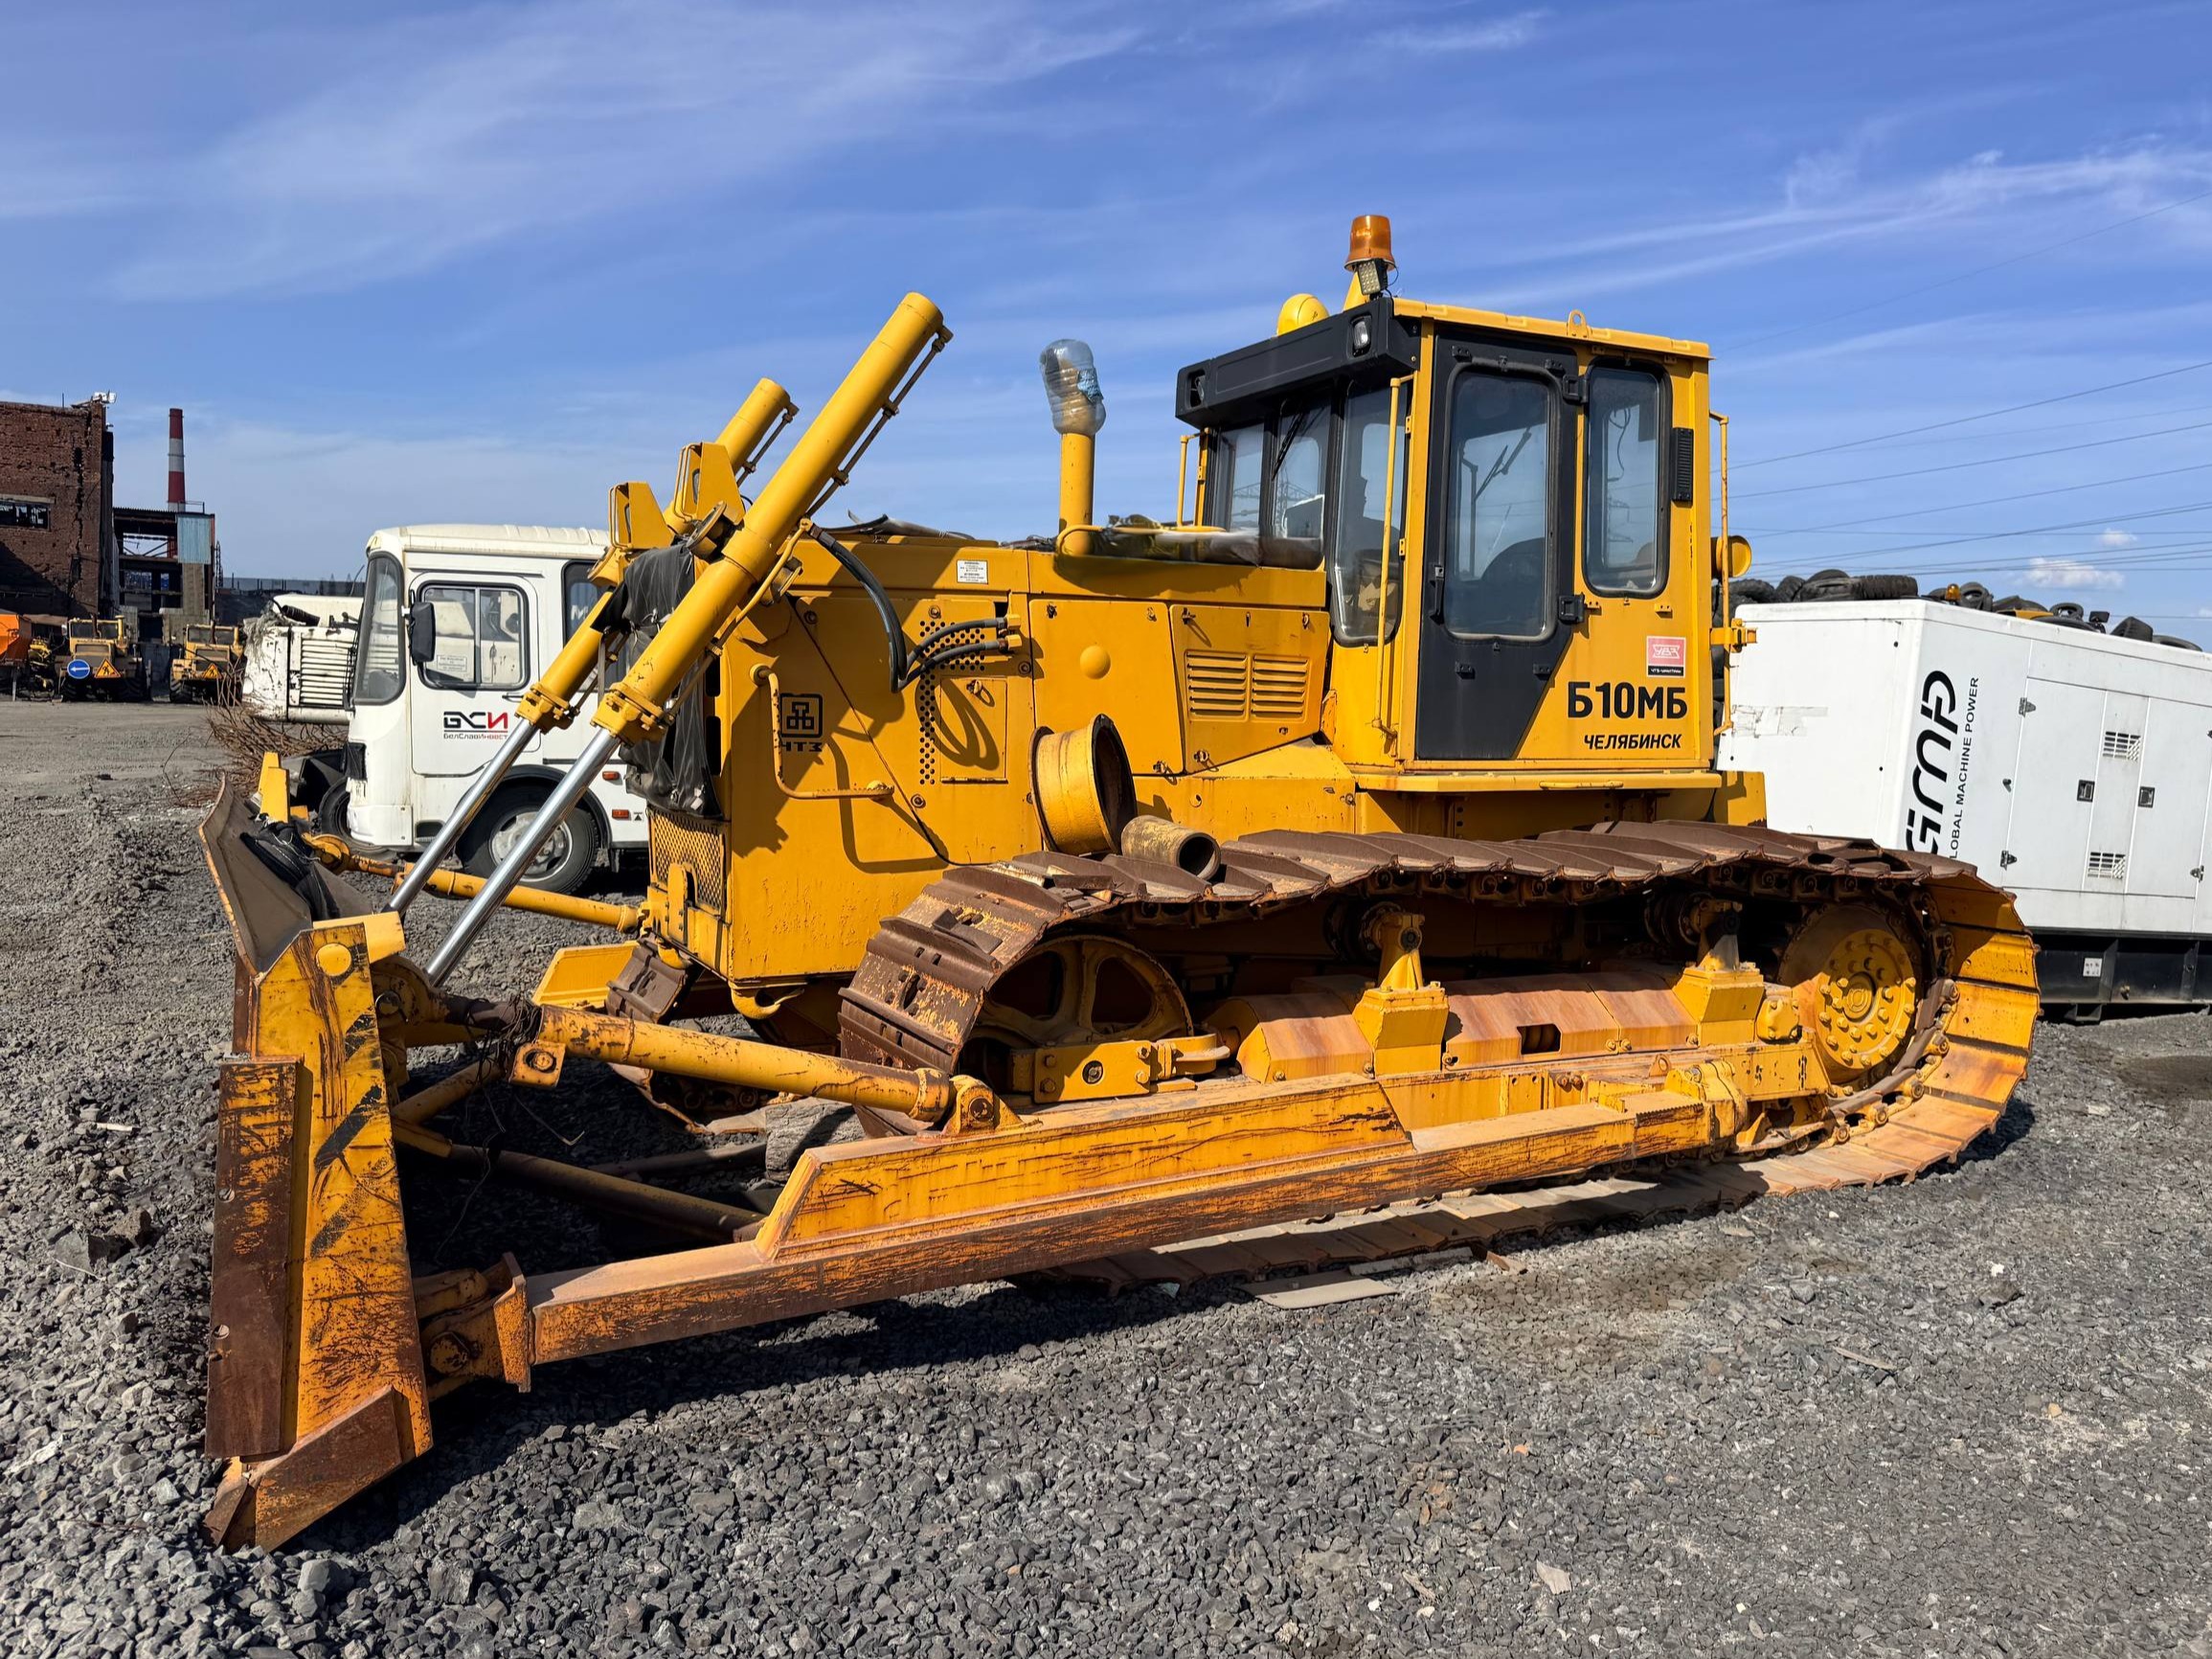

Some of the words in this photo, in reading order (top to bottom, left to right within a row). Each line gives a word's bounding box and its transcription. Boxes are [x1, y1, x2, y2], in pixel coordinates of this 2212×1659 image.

[443, 711, 508, 729] БСИ
[1568, 681, 1688, 719] Б10МБ
[1964, 676, 1979, 733] POWER
[1584, 734, 1682, 750] ЧЕЛЯБИНСК
[1906, 670, 1958, 855] GMP
[1955, 737, 1972, 806] MACHINE
[1949, 809, 1963, 859] LOBAL
